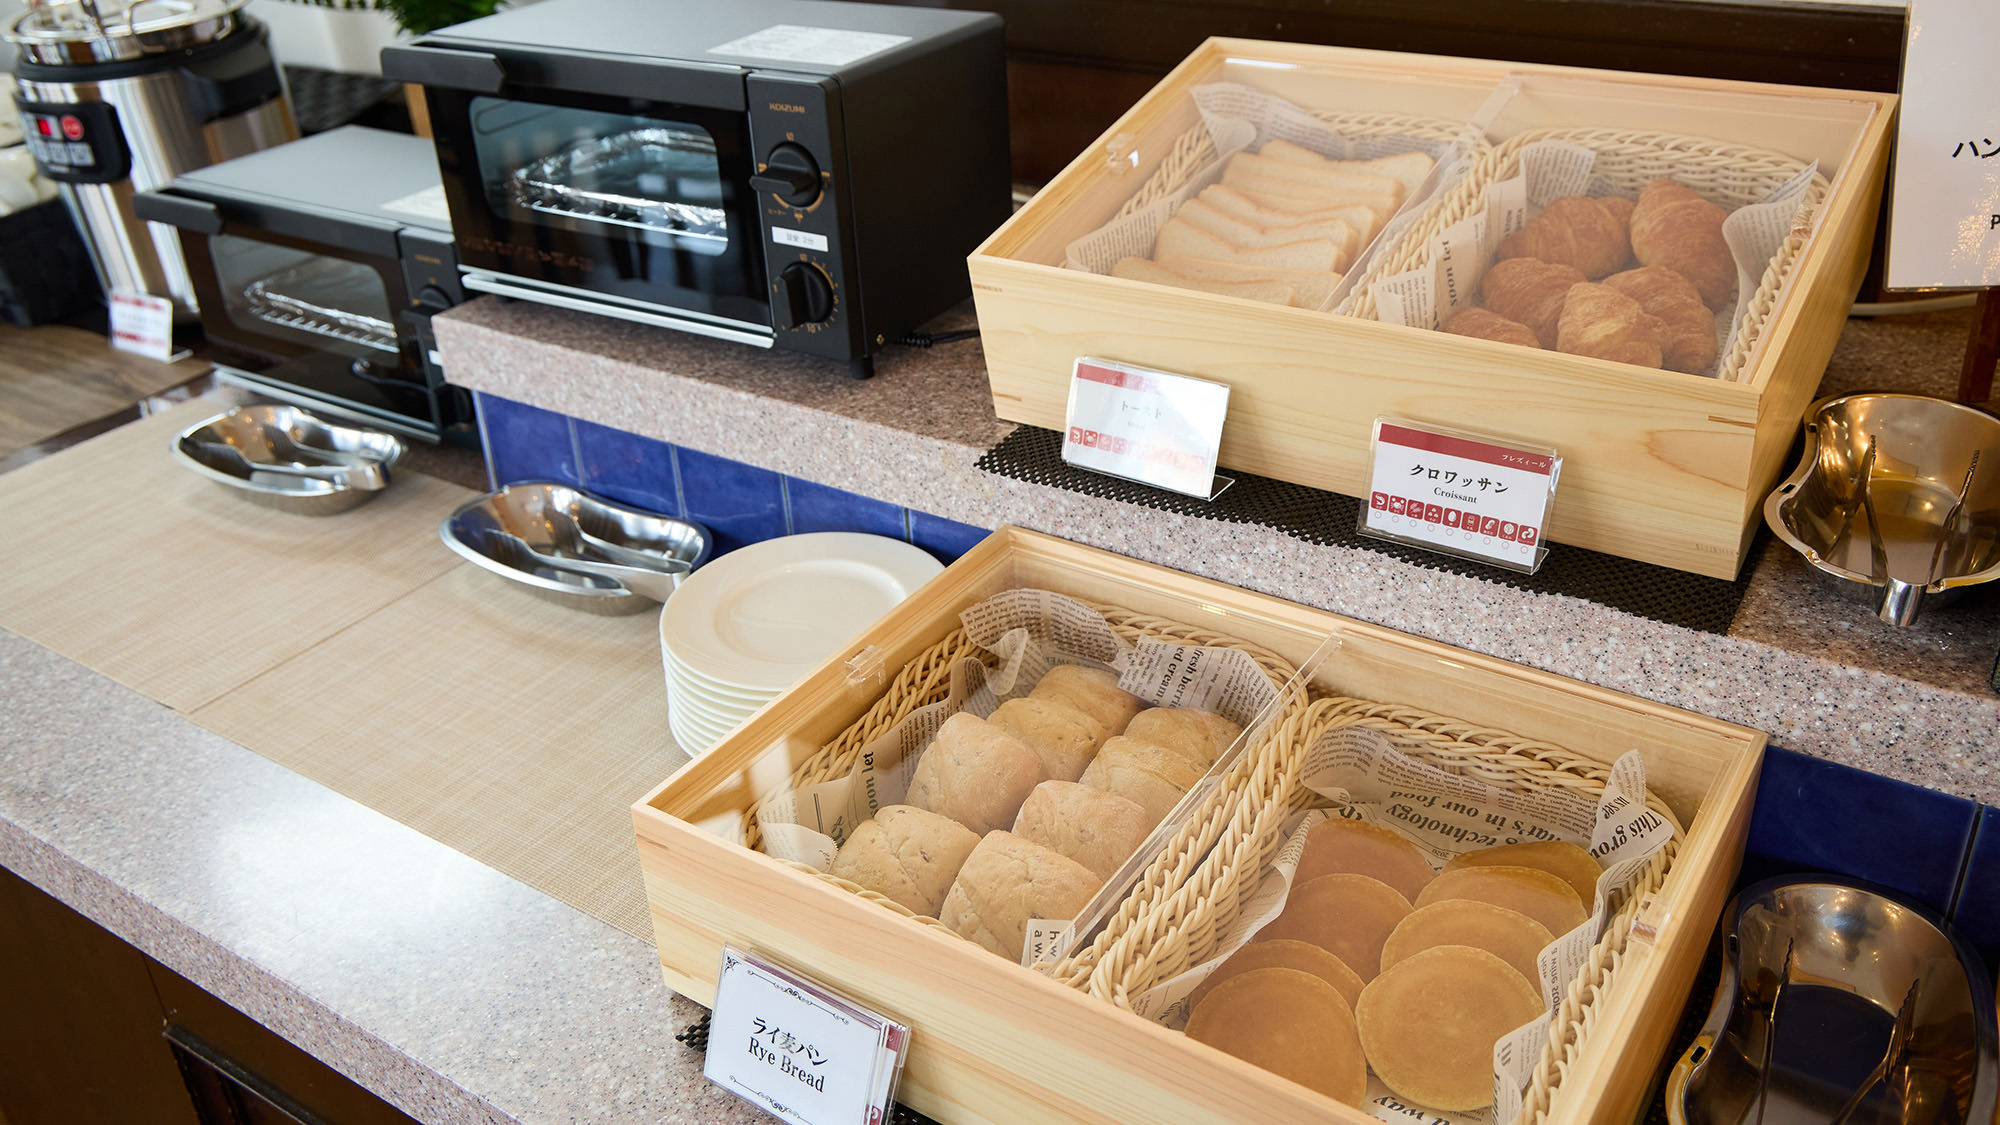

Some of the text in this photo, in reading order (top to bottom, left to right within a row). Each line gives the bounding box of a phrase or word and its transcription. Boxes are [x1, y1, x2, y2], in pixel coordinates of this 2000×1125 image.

[769, 103, 805, 113] KOIZUMI
[1409, 463, 1509, 494] クロワッサン
[1433, 486, 1478, 505] Croissant
[1185, 648, 1205, 674] fresh
[1155, 663, 1177, 698] cream
[861, 751, 875, 775] let
[1389, 790, 1440, 808] food
[1442, 801, 1479, 818] our
[1385, 803, 1497, 847] technology
[1485, 813, 1507, 831] in
[1628, 811, 1663, 840] This
[1034, 929, 1043, 937] a
[752, 1016, 829, 1067] ライ麦パン
[747, 1036, 826, 1093] Rye Bread
[1373, 1095, 1425, 1121] way
